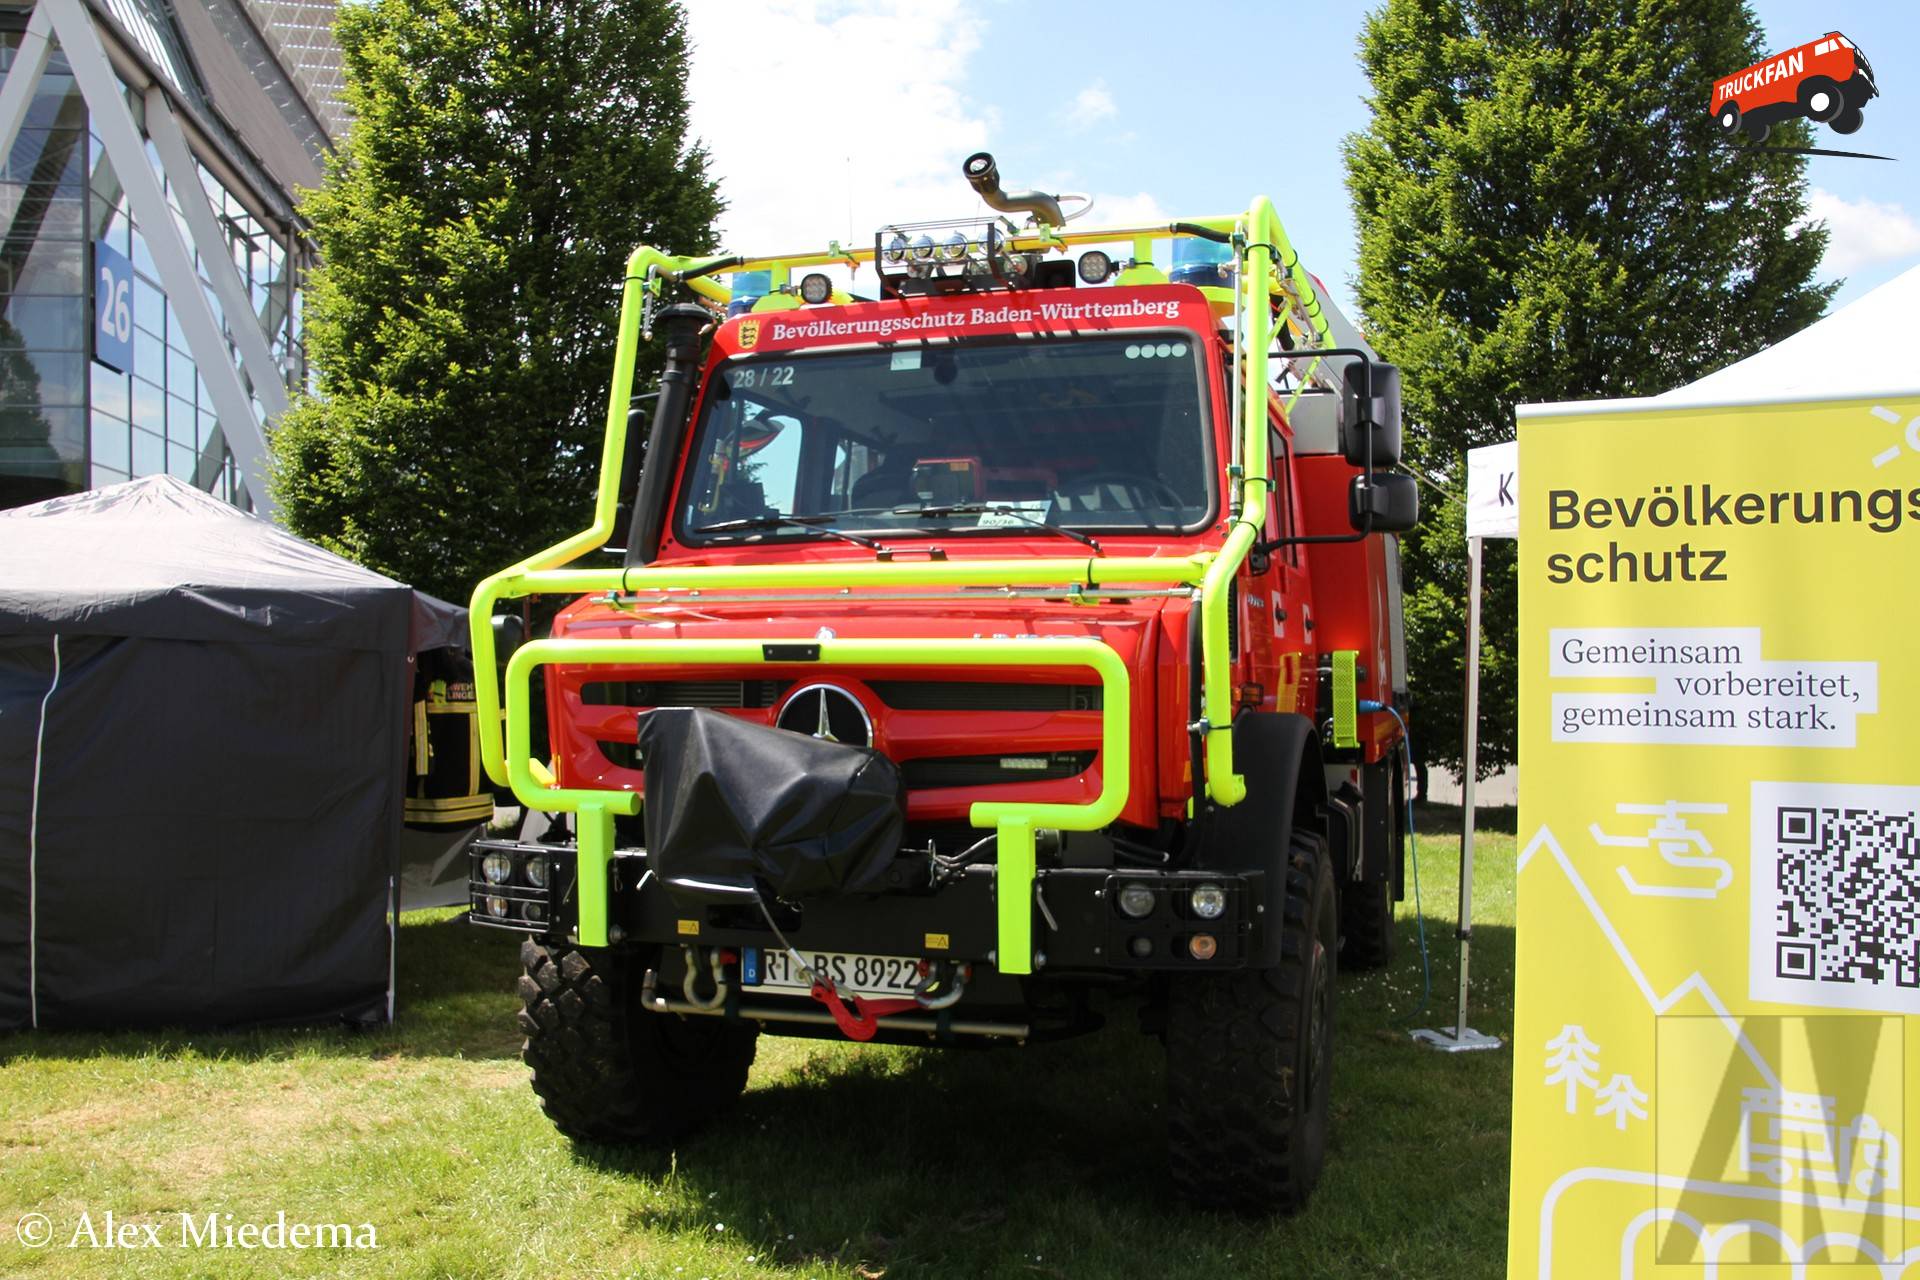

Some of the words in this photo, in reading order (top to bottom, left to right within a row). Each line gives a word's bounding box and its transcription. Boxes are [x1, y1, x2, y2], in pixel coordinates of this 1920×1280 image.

[101, 266, 130, 343] 26
[772, 312, 965, 341] Bevölkerungsschutz
[970, 299, 1180, 325] Baden-Württemberg
[733, 369, 755, 388] 28
[771, 366, 794, 385] 22
[1547, 541, 1728, 584] schutz
[1562, 638, 1742, 664] Gemeinsam
[1675, 671, 1860, 702] vorbereitet,
[1562, 702, 1736, 733] gemeinsam
[1747, 704, 1836, 730] stark.
[854, 957, 917, 989] 8922
